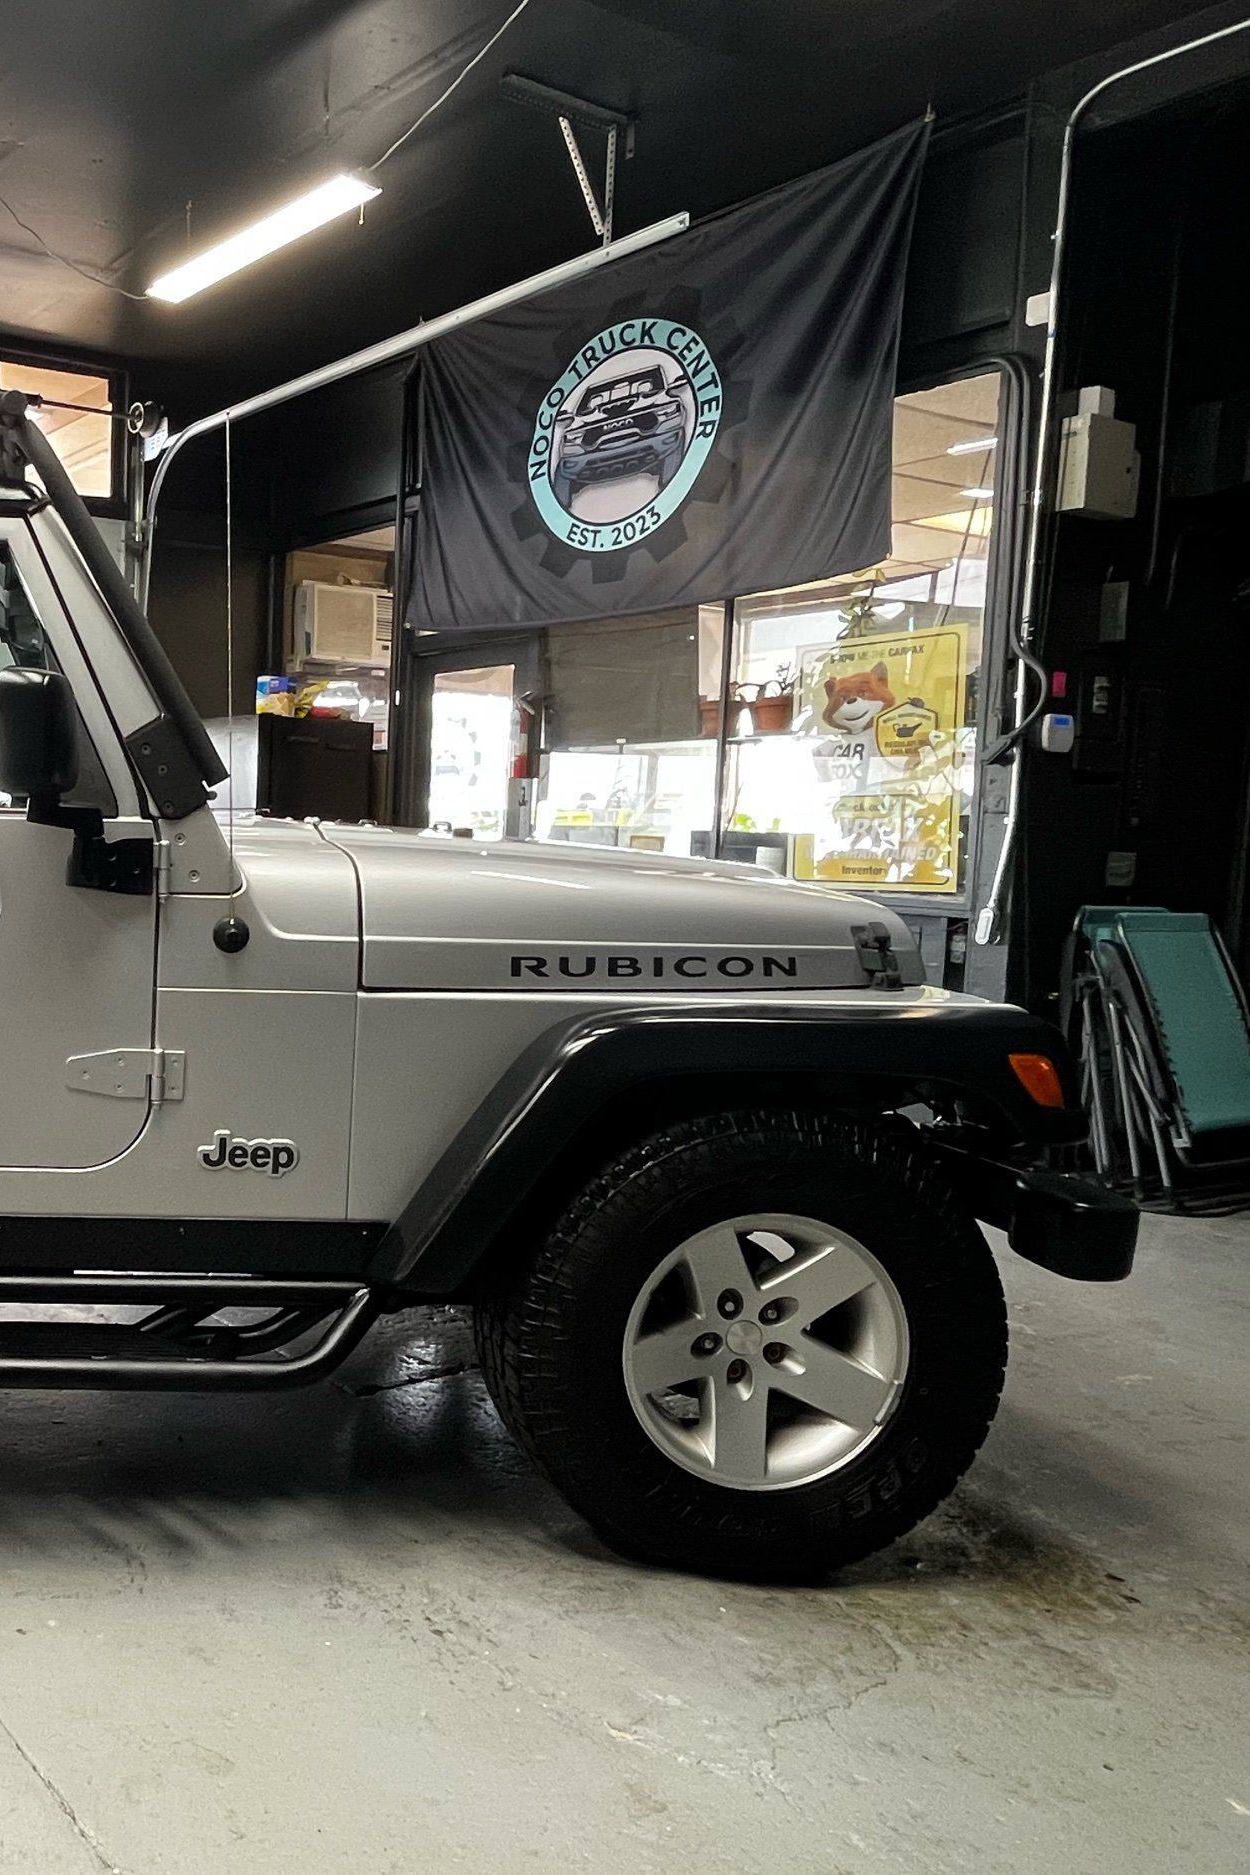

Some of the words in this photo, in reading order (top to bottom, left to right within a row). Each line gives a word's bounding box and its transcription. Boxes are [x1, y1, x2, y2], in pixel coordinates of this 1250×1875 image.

[529, 387, 565, 482] NOCO
[568, 321, 659, 381] TRUCK
[666, 327, 720, 440] CENTER
[566, 523, 605, 548] EST.
[610, 505, 662, 547] 2023
[510, 956, 798, 978] RUBICON
[201, 1135, 296, 1176] Jeep
